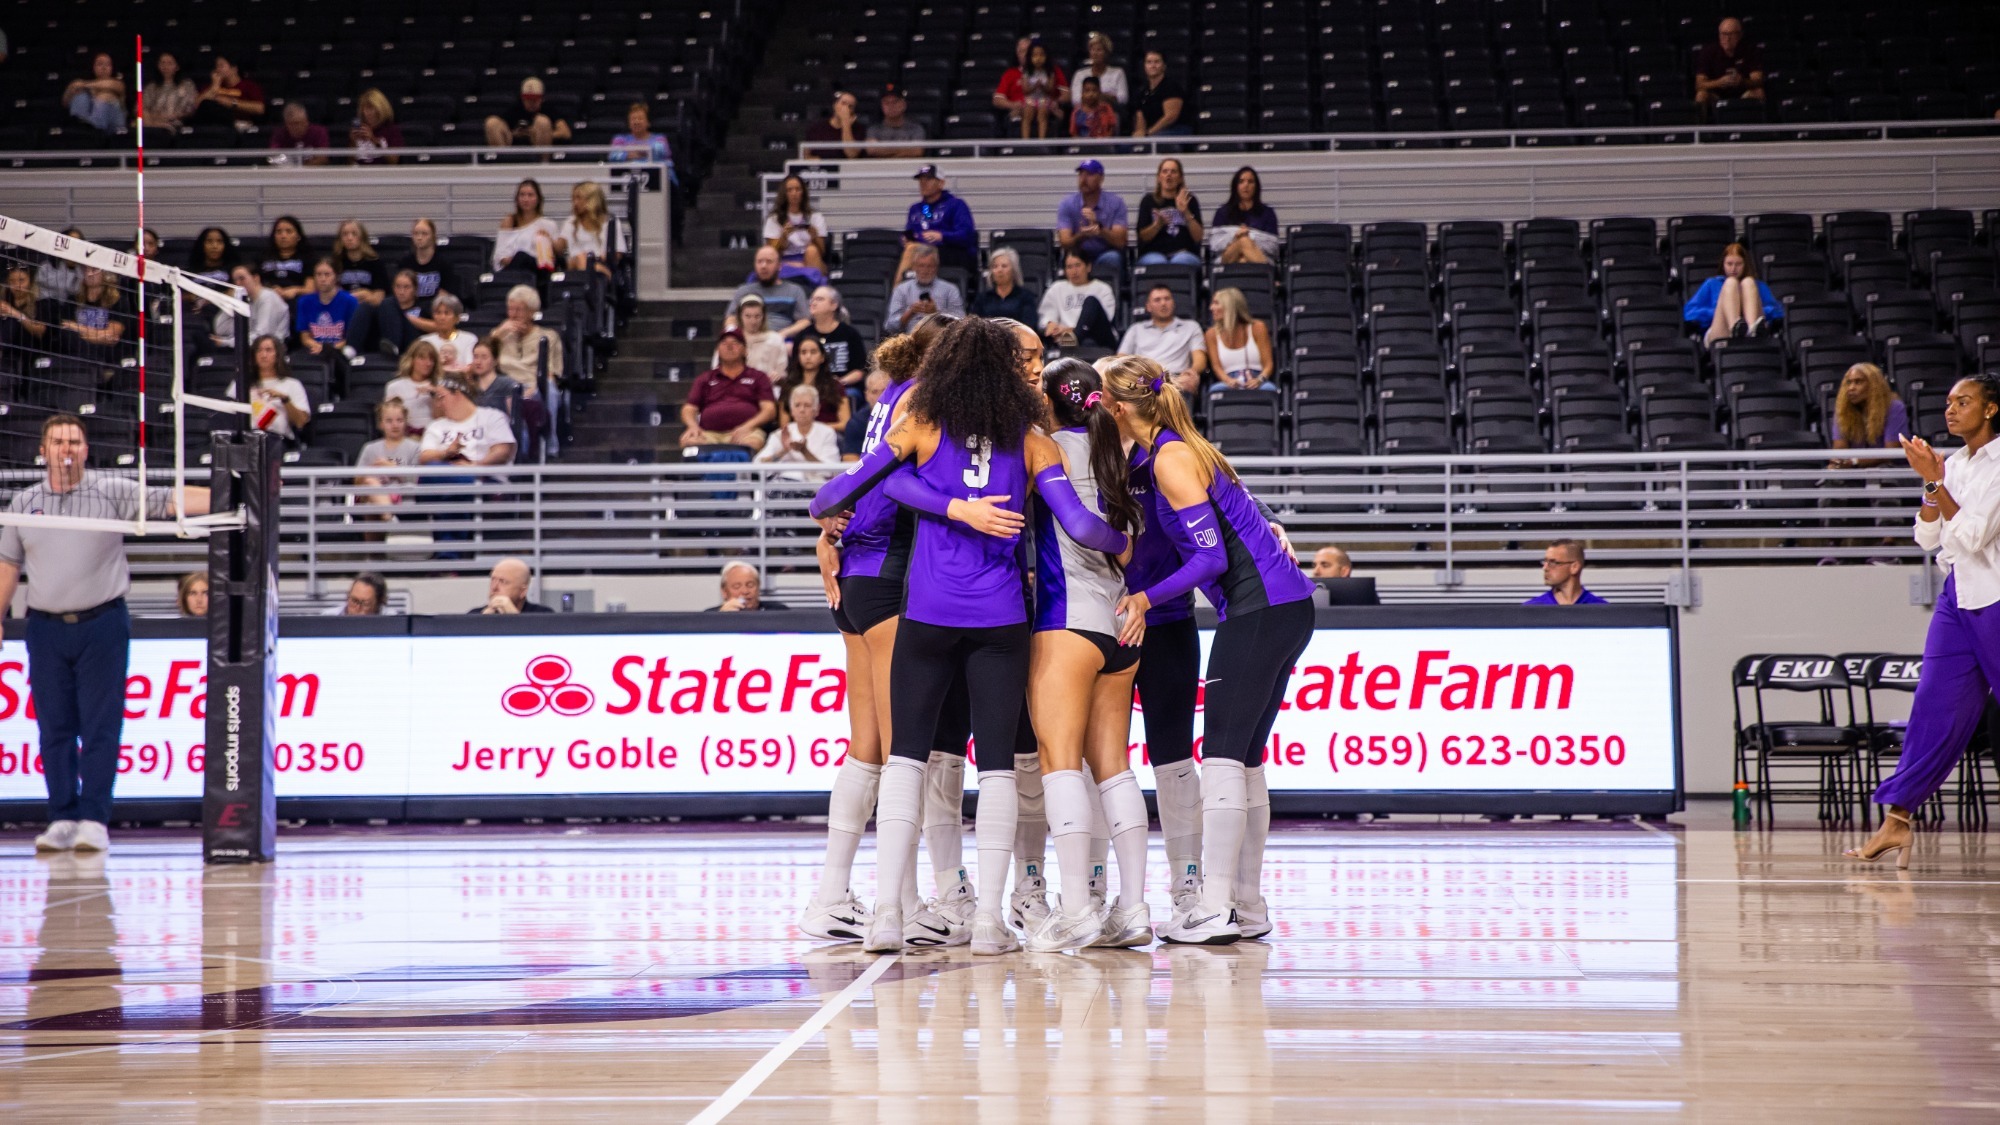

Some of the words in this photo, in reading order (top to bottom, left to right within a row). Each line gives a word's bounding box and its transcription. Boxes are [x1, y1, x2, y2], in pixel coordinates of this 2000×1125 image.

[962, 433, 993, 489] 3
[605, 654, 772, 715] State
[780, 654, 848, 714] Fa
[1278, 650, 1401, 712] ate
[1408, 650, 1575, 712] Farm
[1770, 661, 1835, 678] EKU
[1880, 661, 1923, 678] EK
[225, 685, 241, 733] sports
[224, 733, 240, 791] imports
[452, 741, 555, 778] Jerry
[567, 737, 678, 769] Goble
[700, 735, 796, 775] (859)
[1328, 731, 1428, 773] (859)
[1441, 735, 1627, 766] 623-0350
